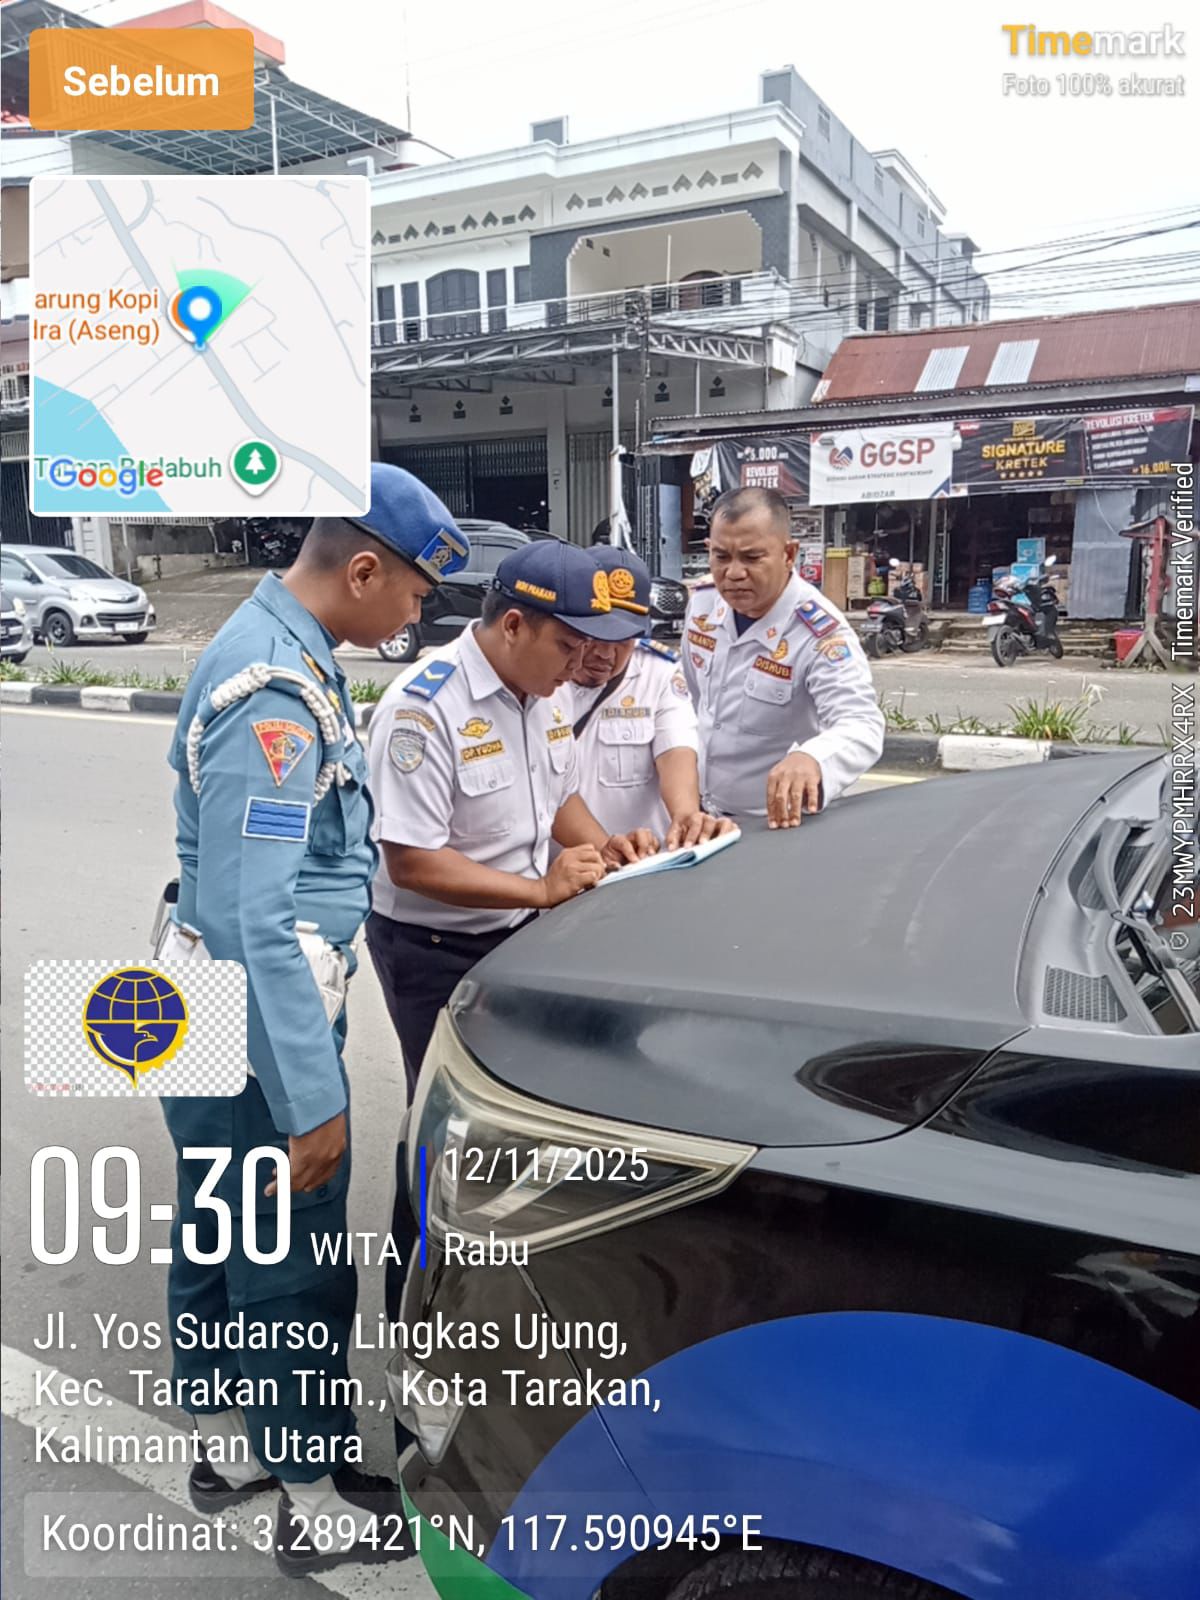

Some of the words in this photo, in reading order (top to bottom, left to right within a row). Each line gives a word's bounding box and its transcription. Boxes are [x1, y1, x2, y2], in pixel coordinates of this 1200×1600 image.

[859, 437, 936, 468] GGSP
[982, 439, 1066, 458] SIGNATURE
[995, 457, 1048, 471] KRETEK
